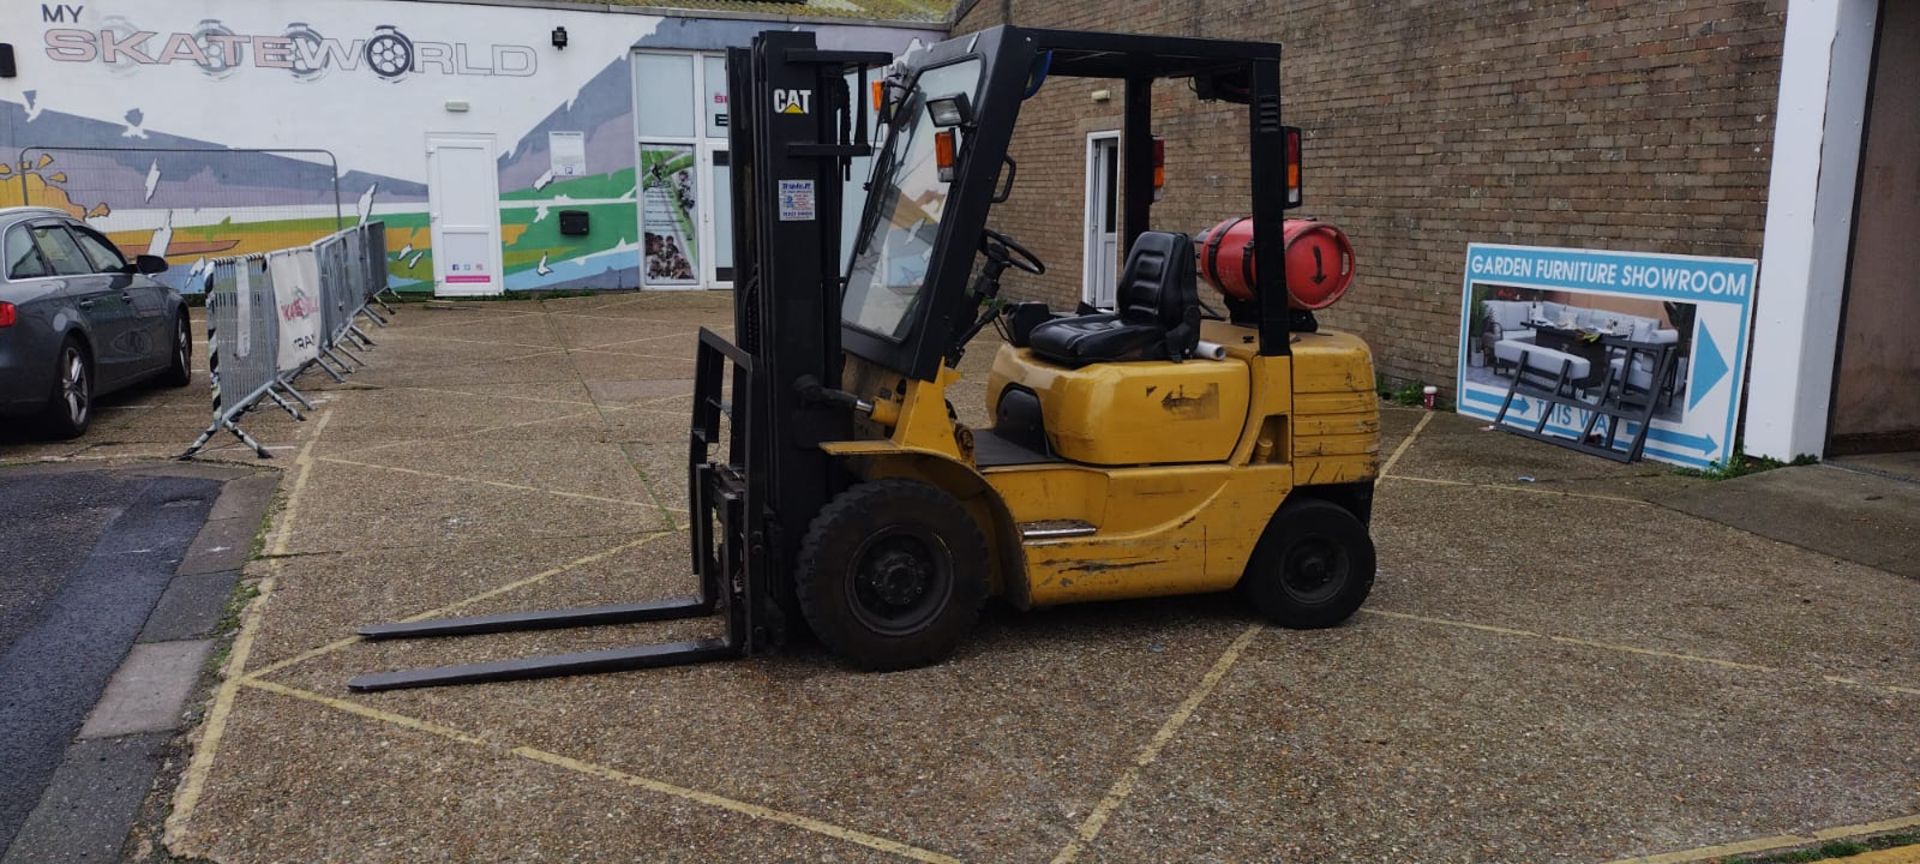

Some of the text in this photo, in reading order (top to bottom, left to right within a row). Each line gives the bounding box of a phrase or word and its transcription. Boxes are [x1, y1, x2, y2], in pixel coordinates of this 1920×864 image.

[42, 4, 84, 23] MY
[44, 27, 538, 78] SKATEWORLD
[773, 89, 812, 114] CAT
[1471, 254, 1748, 297] GARDEN FURNITURE SHOWROOM
